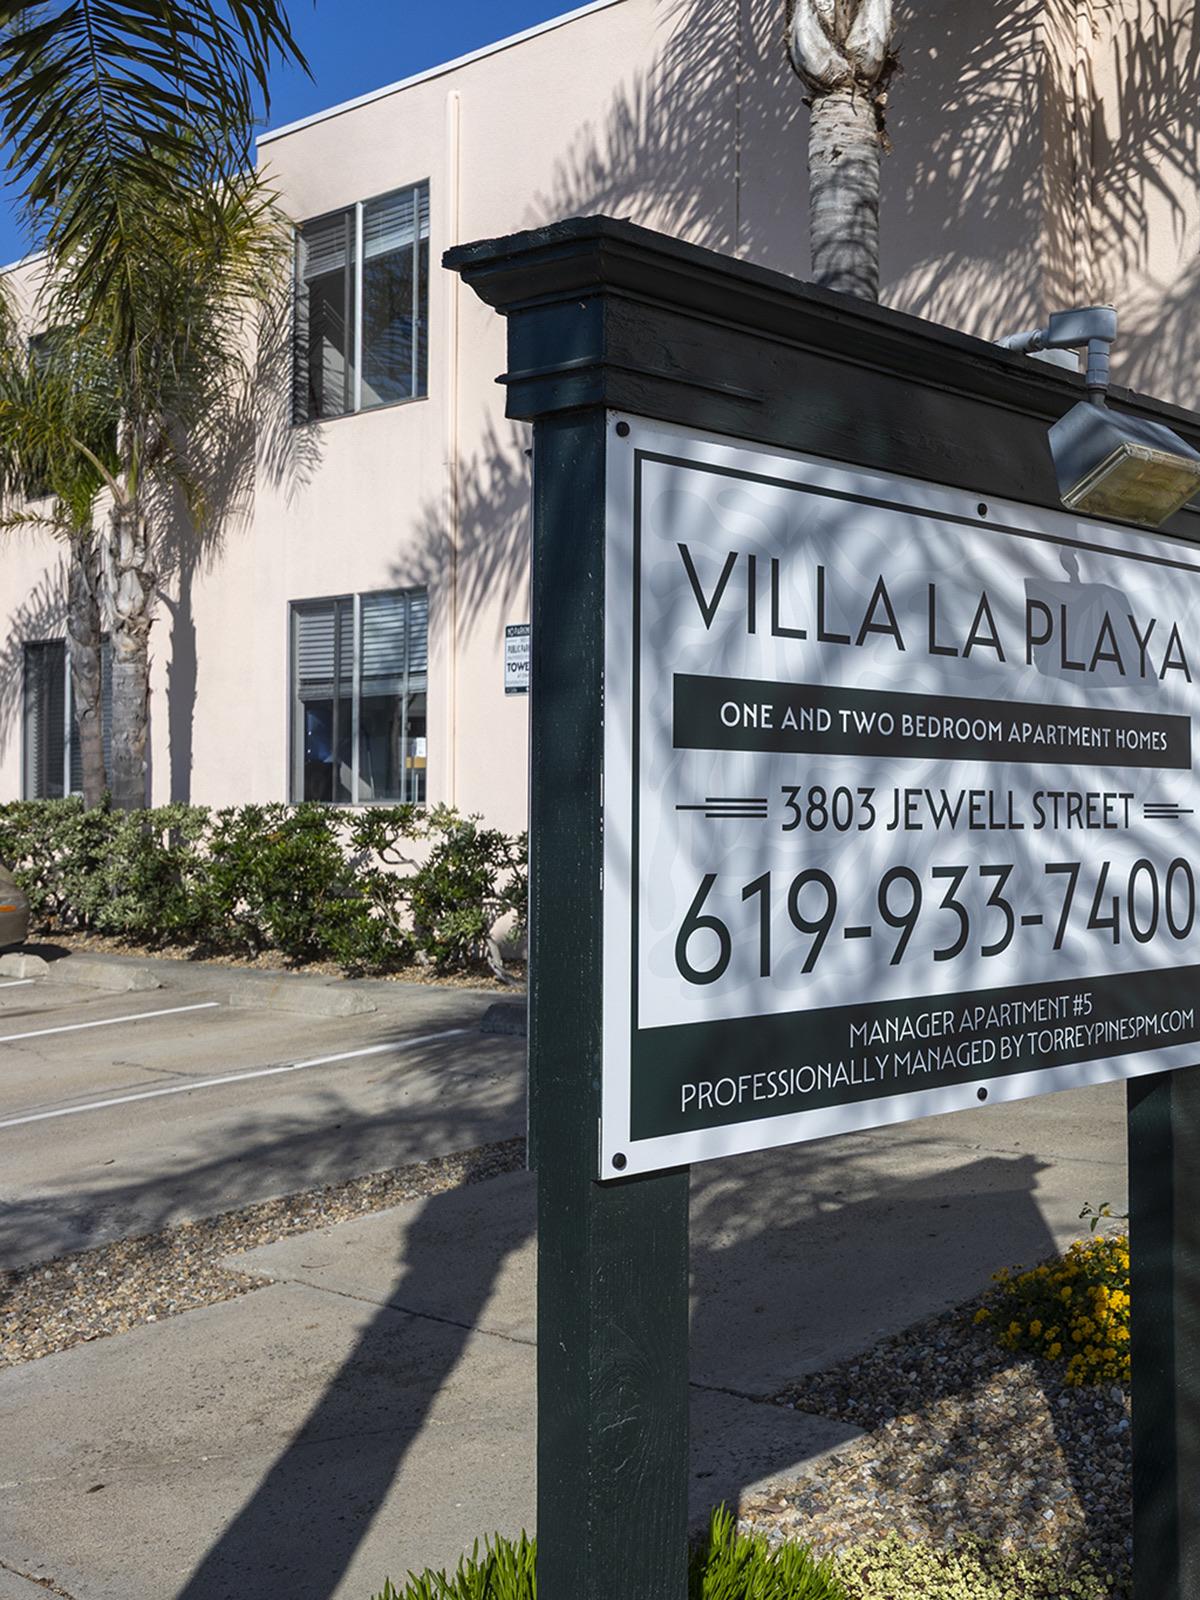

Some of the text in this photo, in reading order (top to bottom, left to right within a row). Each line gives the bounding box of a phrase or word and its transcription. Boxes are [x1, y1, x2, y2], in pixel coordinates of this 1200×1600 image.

[677, 542, 1193, 683] VILLA LA PLAYA
[720, 701, 1168, 752] ONE AND TWO BEDROOM APARTMENT HOMES
[781, 785, 1135, 832] 3803 JEWELL STREET
[674, 857, 1196, 986] 619-933-7400
[681, 1007, 1195, 1113] PROFESSIONALLY MANAGED BY TORREYPINESPM.COM
[850, 992, 1093, 1049] MANAGER APARTMENT #5
